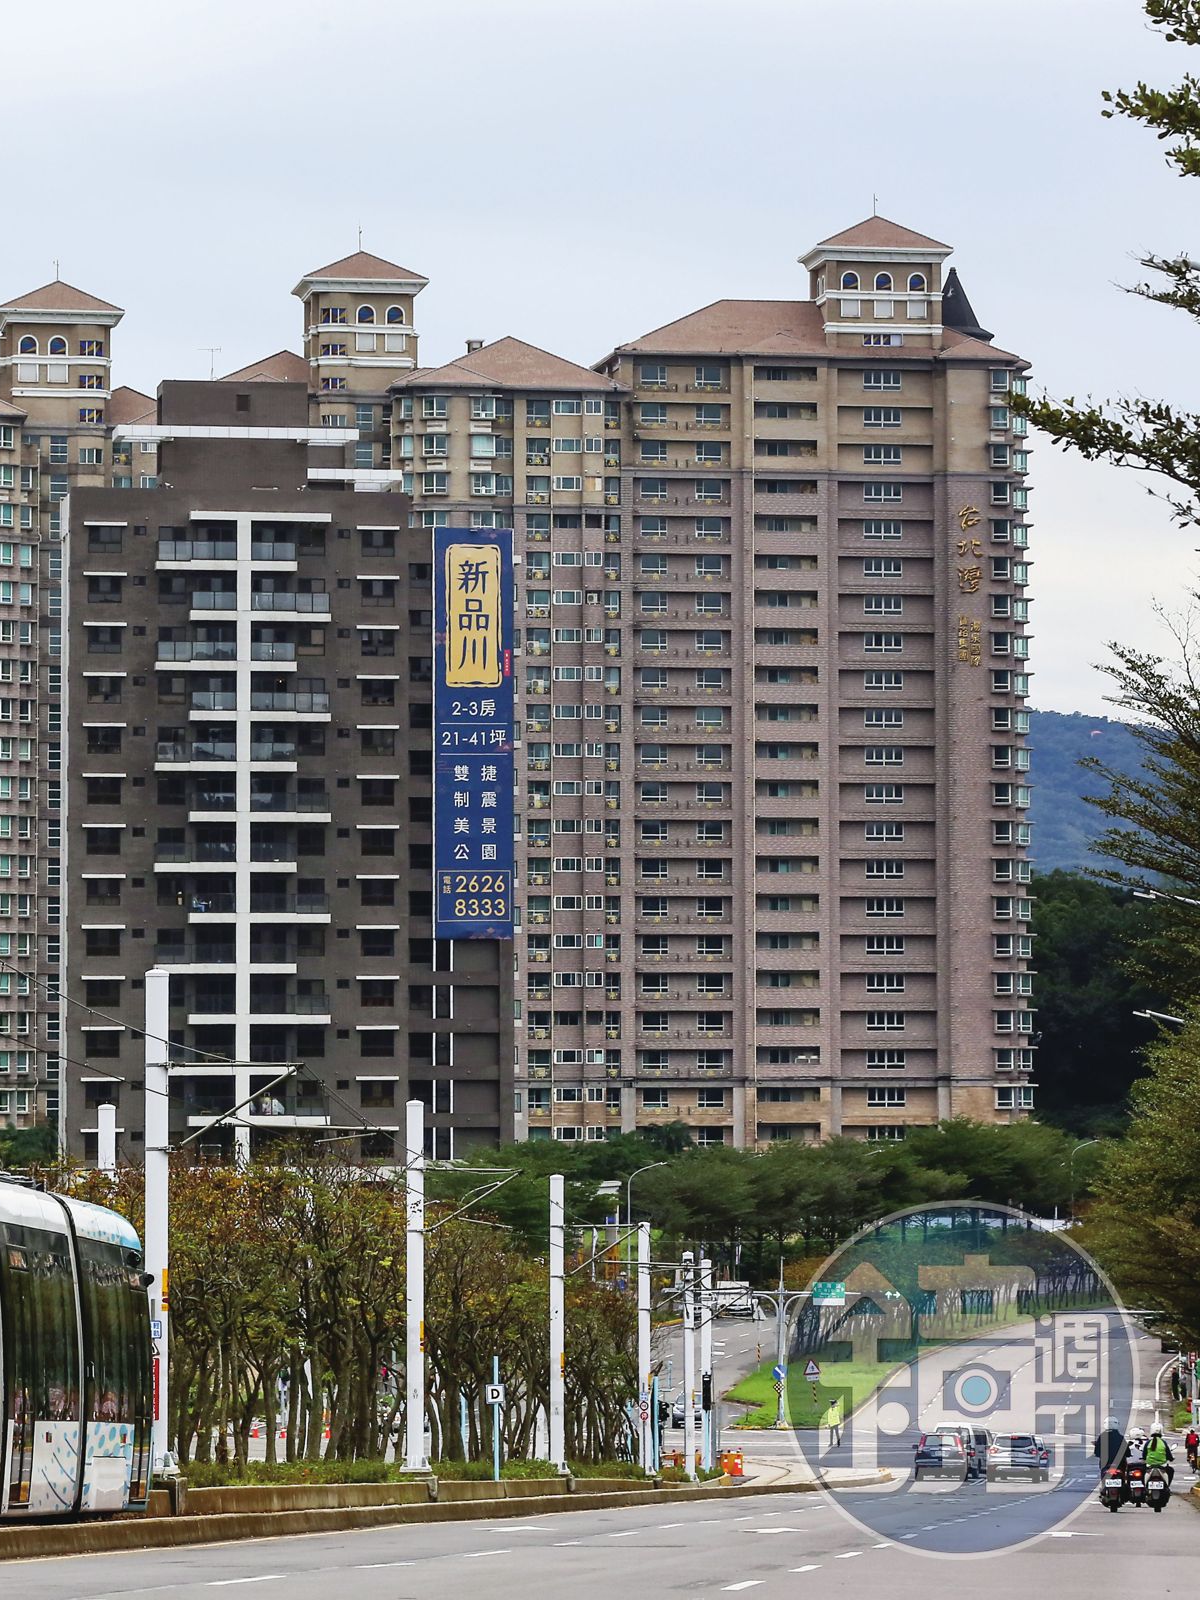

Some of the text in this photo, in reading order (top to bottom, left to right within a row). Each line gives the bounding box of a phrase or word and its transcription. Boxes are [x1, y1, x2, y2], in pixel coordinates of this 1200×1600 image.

[457, 560, 489, 671] 新品川
[452, 700, 497, 717] 2-3房
[442, 730, 507, 748] 21-41坪
[454, 765, 497, 782] 雙捷
[454, 791, 497, 809] 制震
[454, 817, 497, 834] 美景
[454, 843, 497, 861] 公園
[455, 875, 505, 893] 2626
[455, 899, 506, 917] 8333
[491, 1388, 500, 1399] D
